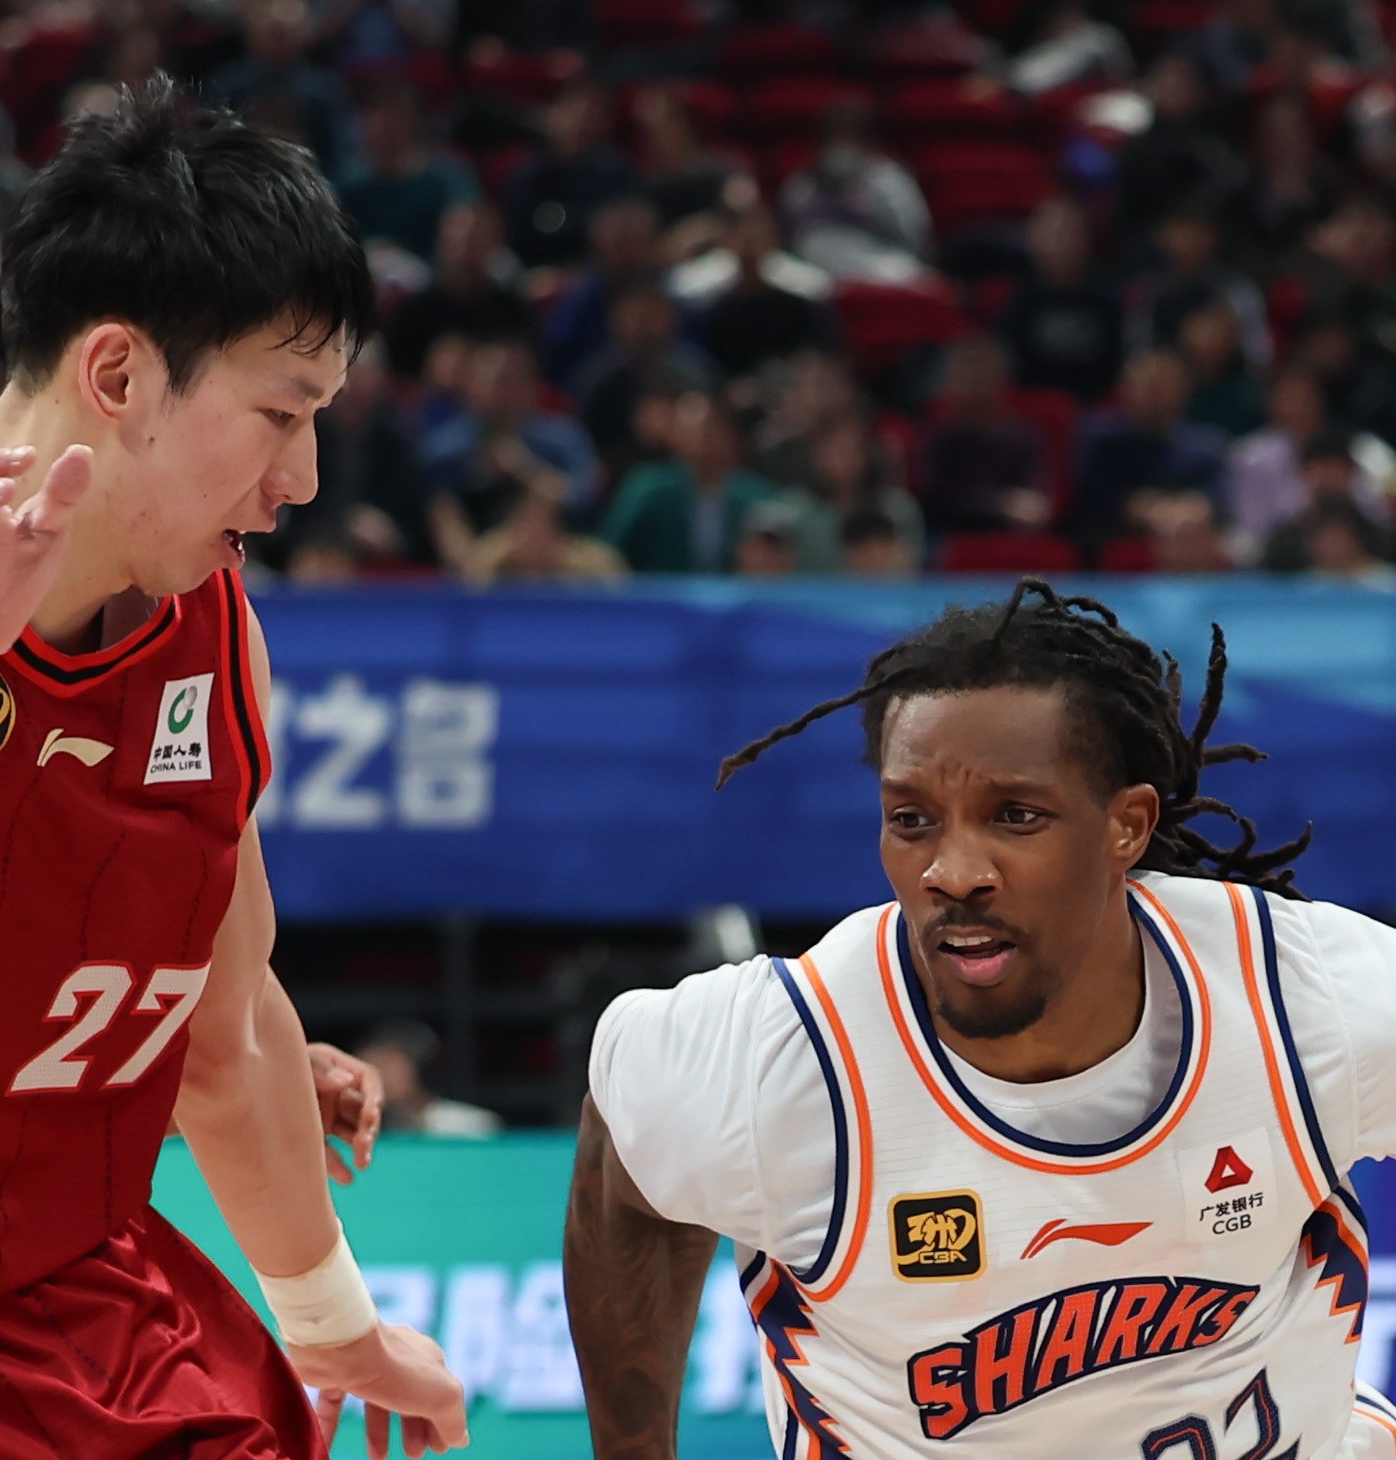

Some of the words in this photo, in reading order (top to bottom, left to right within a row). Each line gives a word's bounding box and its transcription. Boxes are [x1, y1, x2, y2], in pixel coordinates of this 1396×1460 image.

[153, 742, 202, 762] 中国人寿
[150, 762, 176, 774] CHINA
[179, 760, 203, 771] LIFE
[6, 959, 212, 1097] 27
[1199, 1192, 1264, 1222] 广发银行
[1212, 1213, 1252, 1235] CGB
[919, 1250, 968, 1265] CBA
[907, 1276, 1261, 1441] SHARKS
